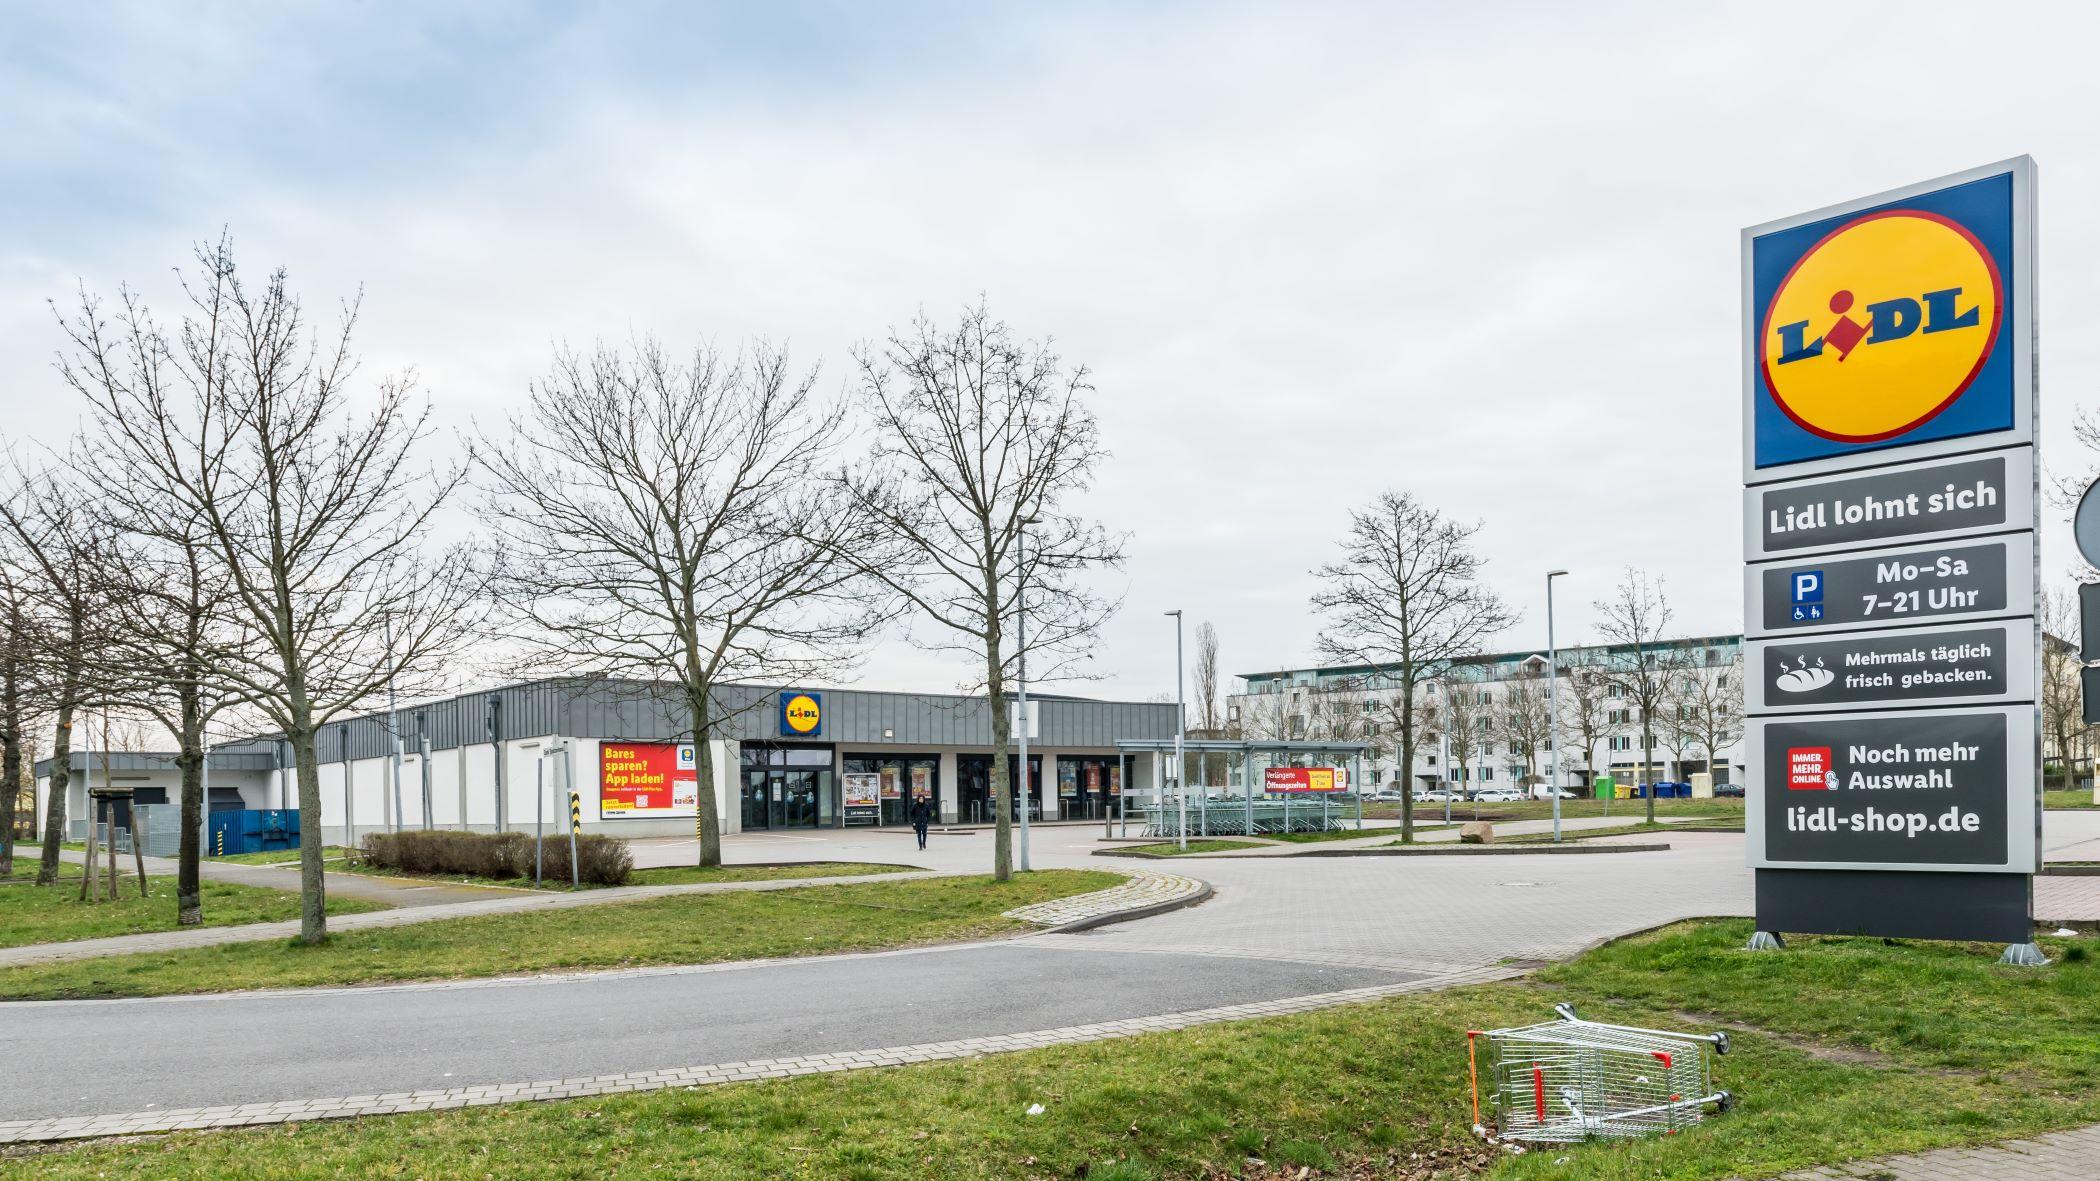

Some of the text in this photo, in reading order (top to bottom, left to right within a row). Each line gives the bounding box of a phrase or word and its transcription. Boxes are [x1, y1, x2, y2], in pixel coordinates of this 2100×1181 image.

[1777, 287, 1980, 366] LIDL
[1770, 480, 1997, 534] Lidl lohnt sich
[1796, 574, 1818, 601] P
[1928, 586, 1979, 610] Uhr
[1845, 643, 1992, 667] Mehrmals täglich
[1845, 667, 1992, 689] frisch gebacken.
[789, 707, 818, 719] LIDL
[605, 747, 635, 759] Bares
[1792, 753, 1823, 763] IMMER.
[1849, 741, 1980, 764] Noch mehr
[605, 760, 648, 773] sparen?
[1266, 771, 1296, 780] Verlängerte
[1792, 763, 1824, 774] MEHR.
[605, 773, 664, 787] App laden!
[1266, 780, 1307, 790] Öffnungszeiten
[1792, 774, 1824, 784] ONLINE.
[1848, 768, 1953, 790] Auswahl
[1787, 805, 1980, 838] lidl-shop.de
